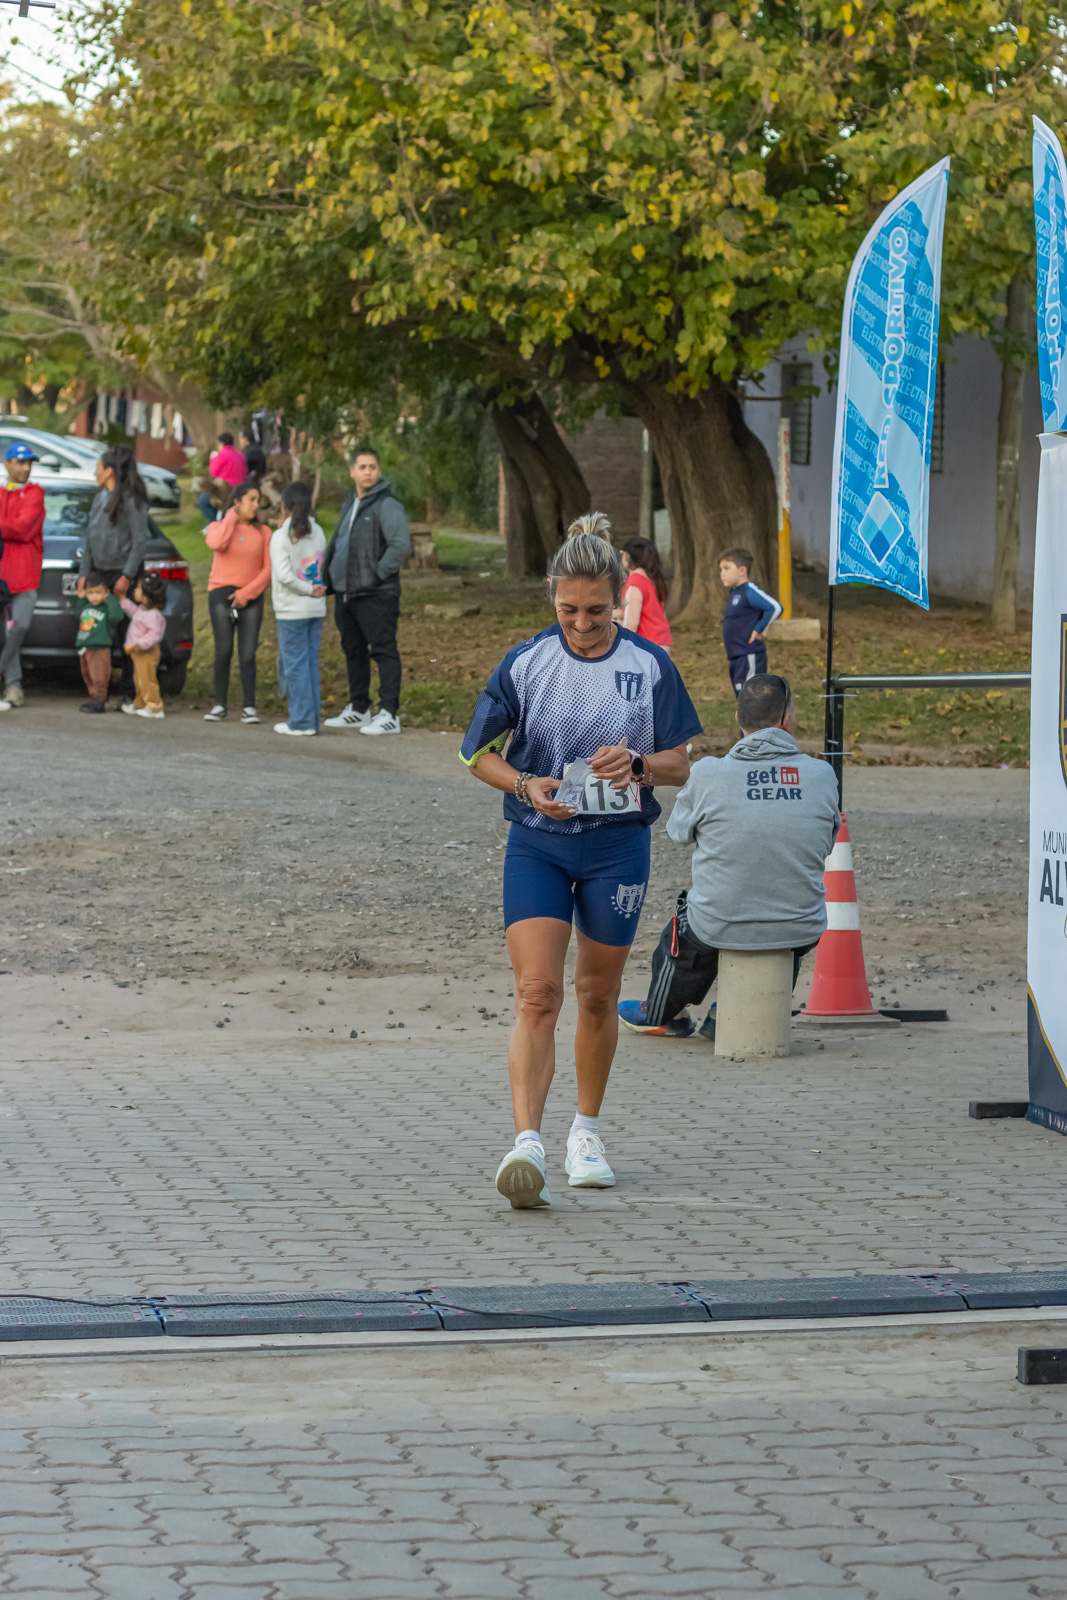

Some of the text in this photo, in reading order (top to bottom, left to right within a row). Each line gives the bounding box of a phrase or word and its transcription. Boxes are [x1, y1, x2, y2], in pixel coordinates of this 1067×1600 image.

[881, 226, 909, 409] SPORTIVO
[620, 673, 638, 682] SFC
[746, 766, 798, 786] get in
[746, 787, 802, 800] GEAR
[1039, 858, 1067, 906] AL
